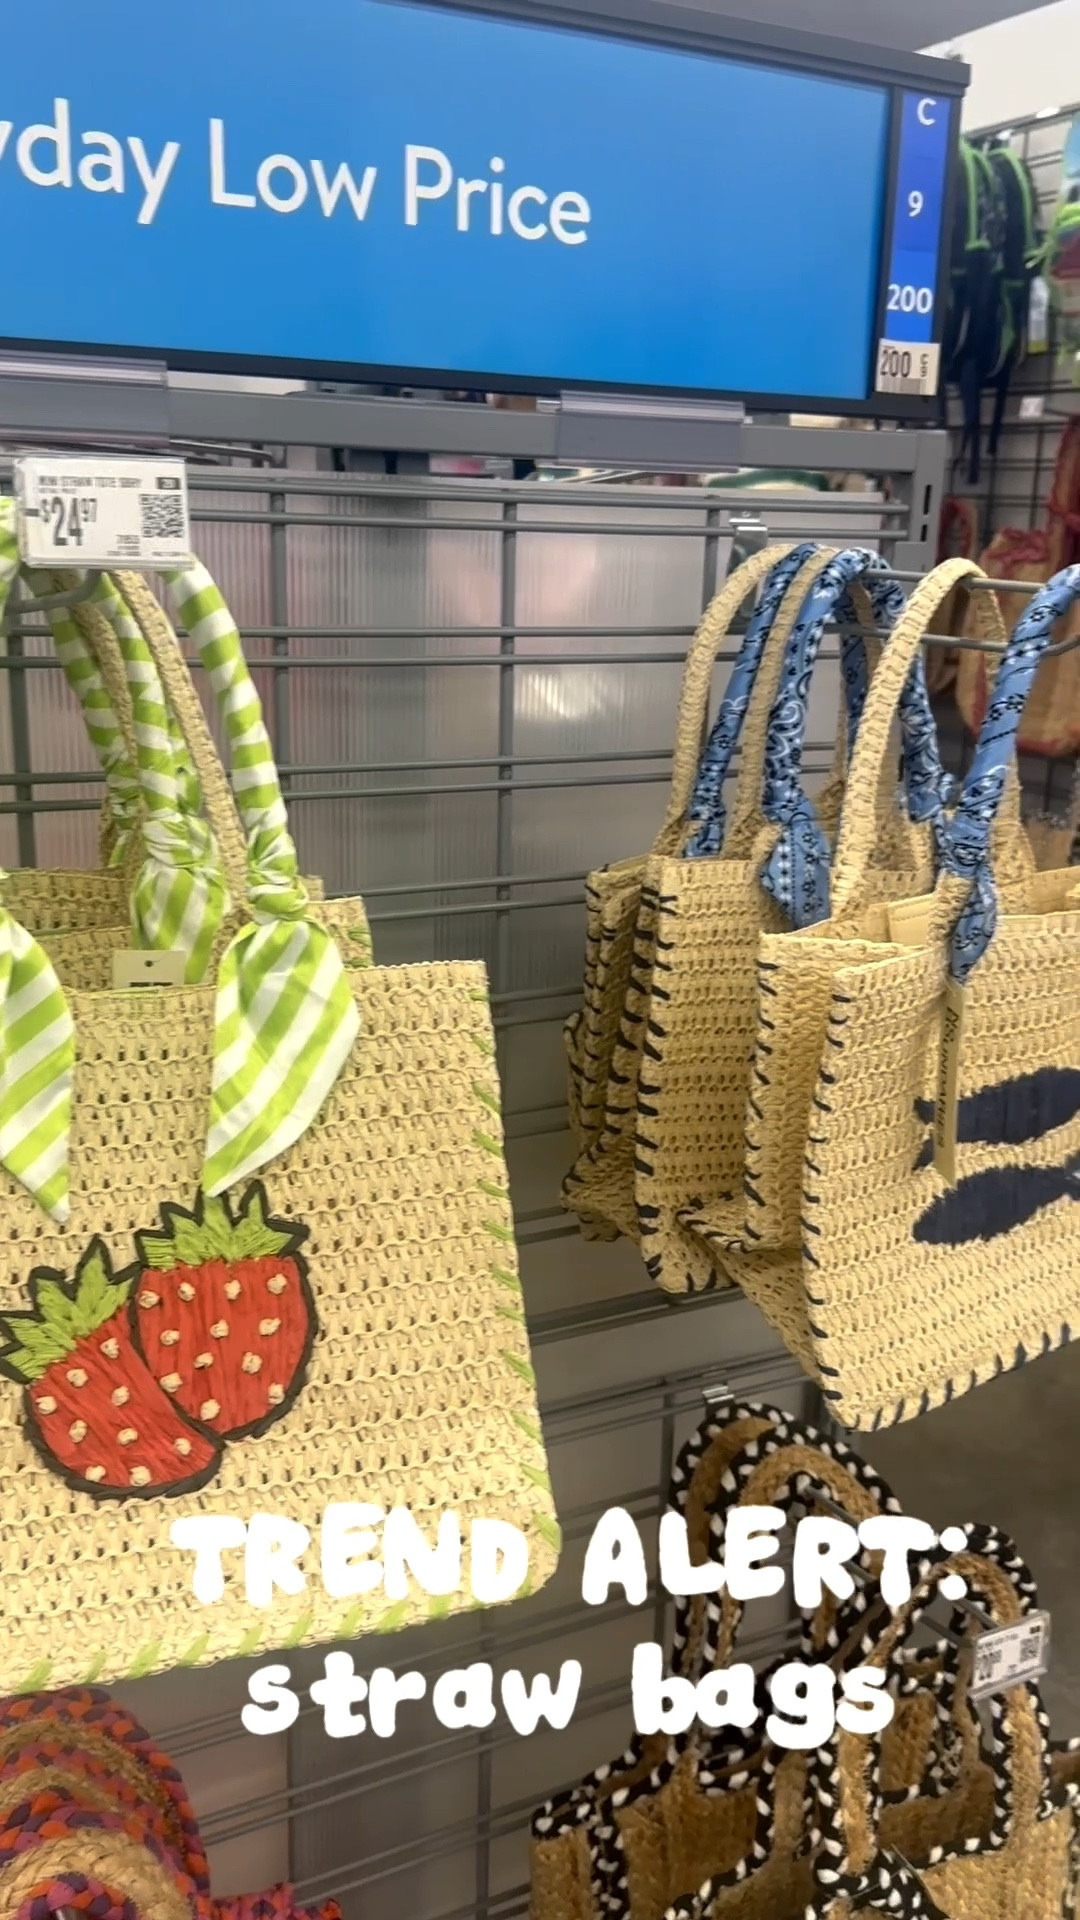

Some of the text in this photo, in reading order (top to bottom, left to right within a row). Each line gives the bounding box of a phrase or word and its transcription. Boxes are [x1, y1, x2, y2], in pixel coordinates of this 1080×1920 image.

[917, 97, 937, 126] C
[0, 97, 592, 245] day Low Price
[908, 190, 924, 217] 9
[886, 283, 933, 314] 200
[879, 349, 911, 378] 200
